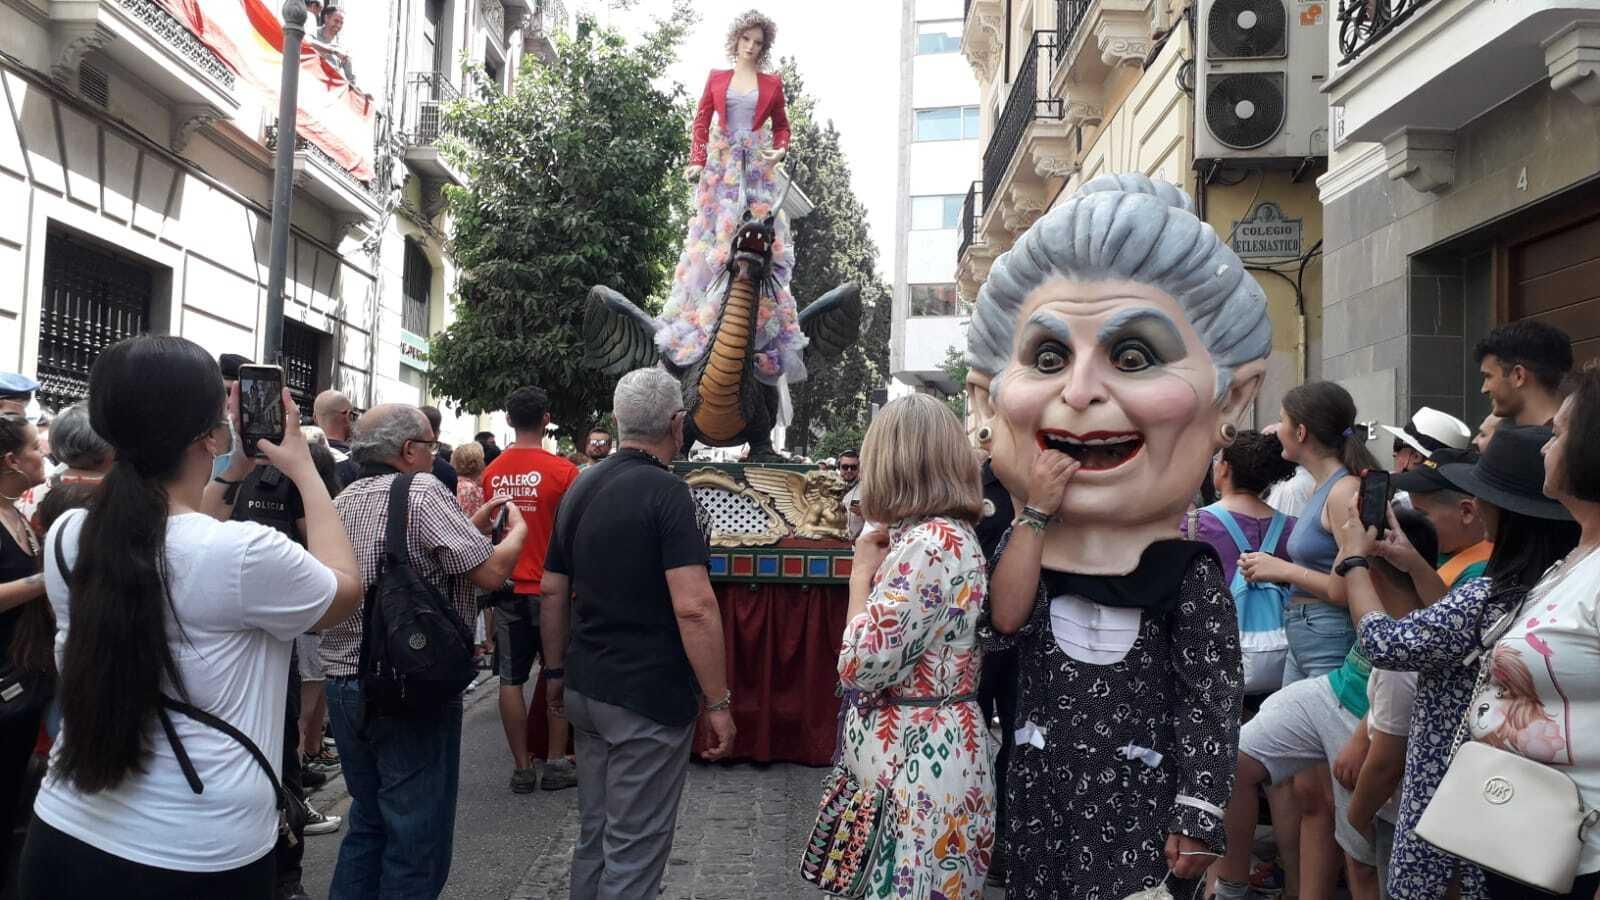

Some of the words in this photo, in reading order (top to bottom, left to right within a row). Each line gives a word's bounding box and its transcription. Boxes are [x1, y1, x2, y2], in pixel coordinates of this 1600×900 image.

[1516, 166, 1529, 192] 4
[1242, 226, 1293, 237] COLEGIO
[491, 471, 542, 489] CALERO
